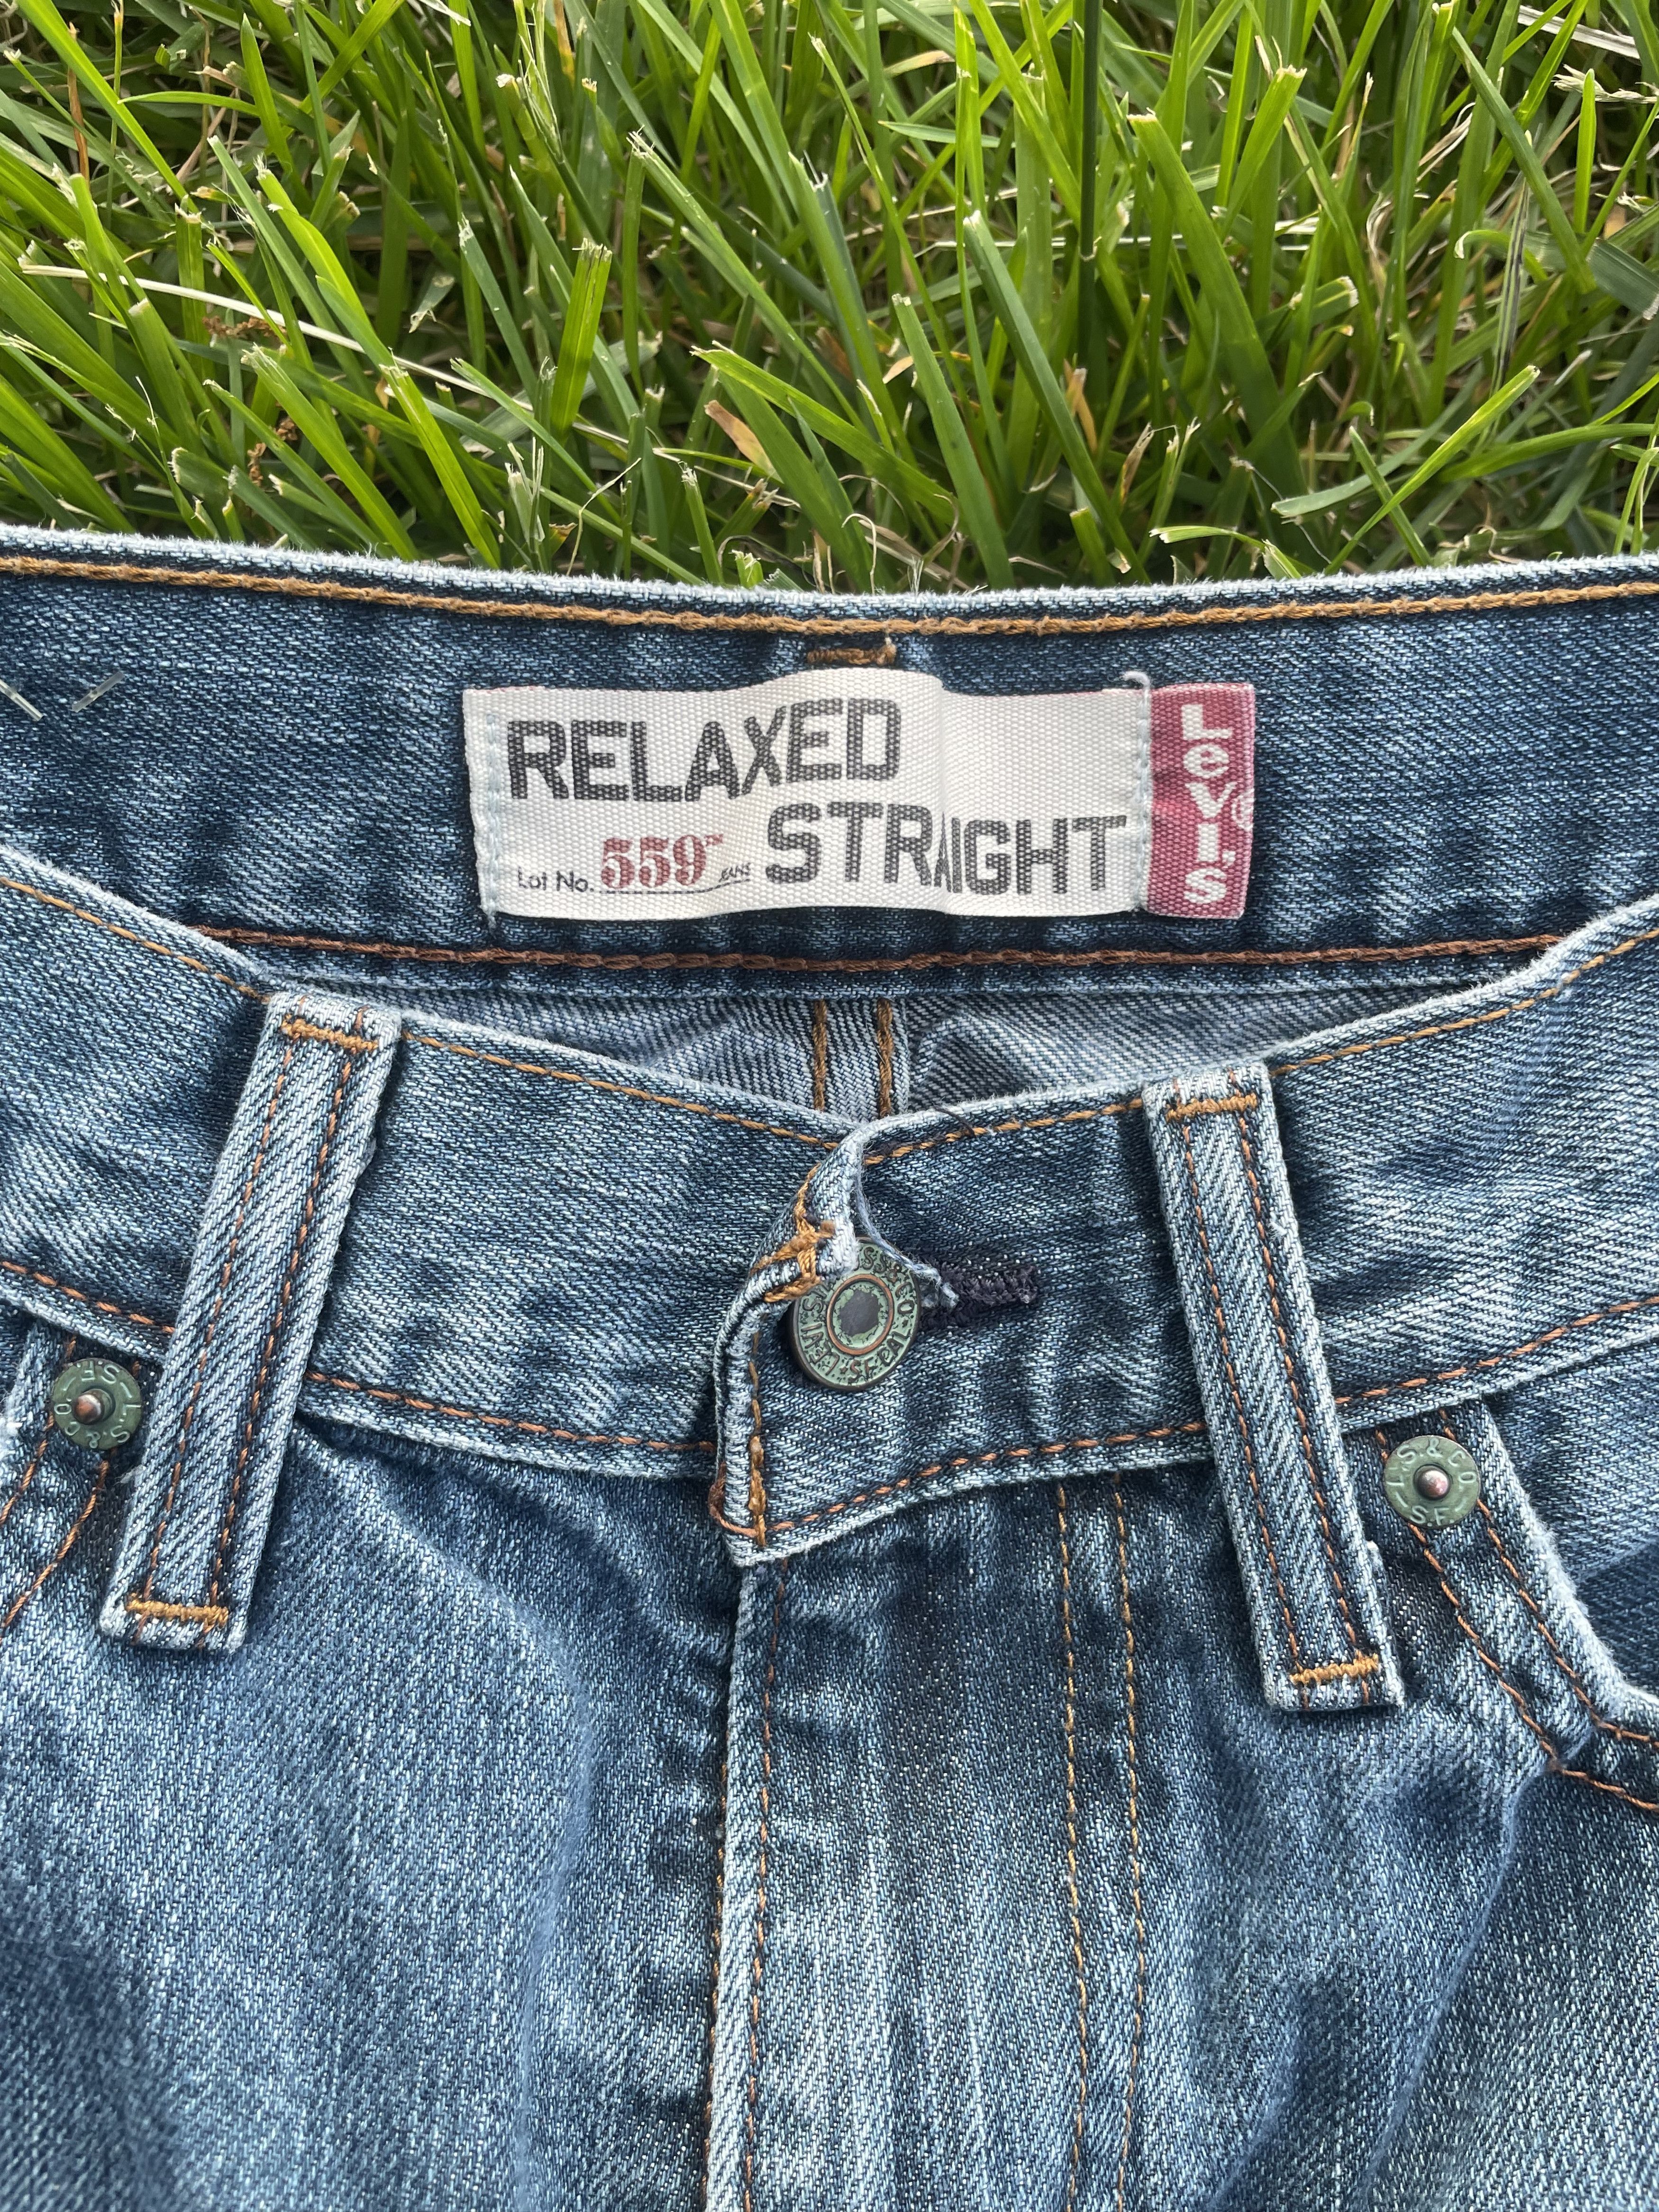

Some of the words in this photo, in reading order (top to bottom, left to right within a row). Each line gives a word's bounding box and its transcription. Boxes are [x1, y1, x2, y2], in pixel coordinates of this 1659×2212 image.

[507, 698, 902, 802] RELAXED
[518, 866, 547, 889] Lot
[556, 870, 594, 892] No.
[765, 801, 1127, 895] STRAIGHT
